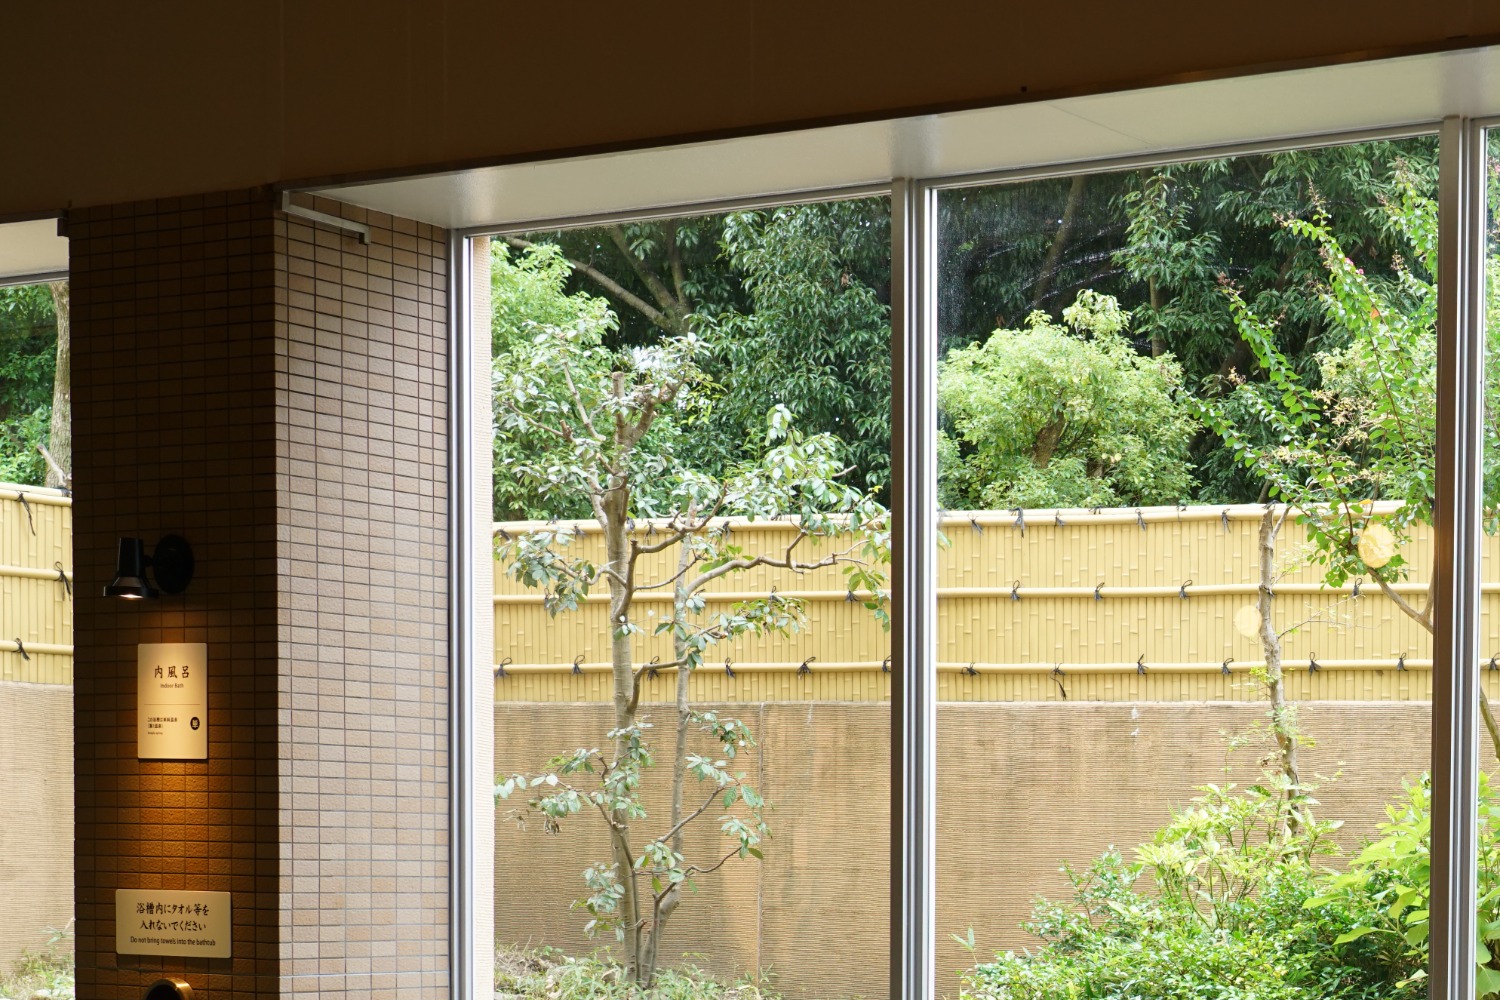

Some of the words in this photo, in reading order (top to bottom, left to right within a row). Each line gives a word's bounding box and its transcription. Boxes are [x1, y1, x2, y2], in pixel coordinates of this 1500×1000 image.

[154, 665, 190, 679] 内風呂
[136, 902, 210, 917] 浴槽内にタオル等を
[140, 919, 207, 932] 入れないでください
[147, 936, 160, 945] bring
[187, 938, 196, 946] the
